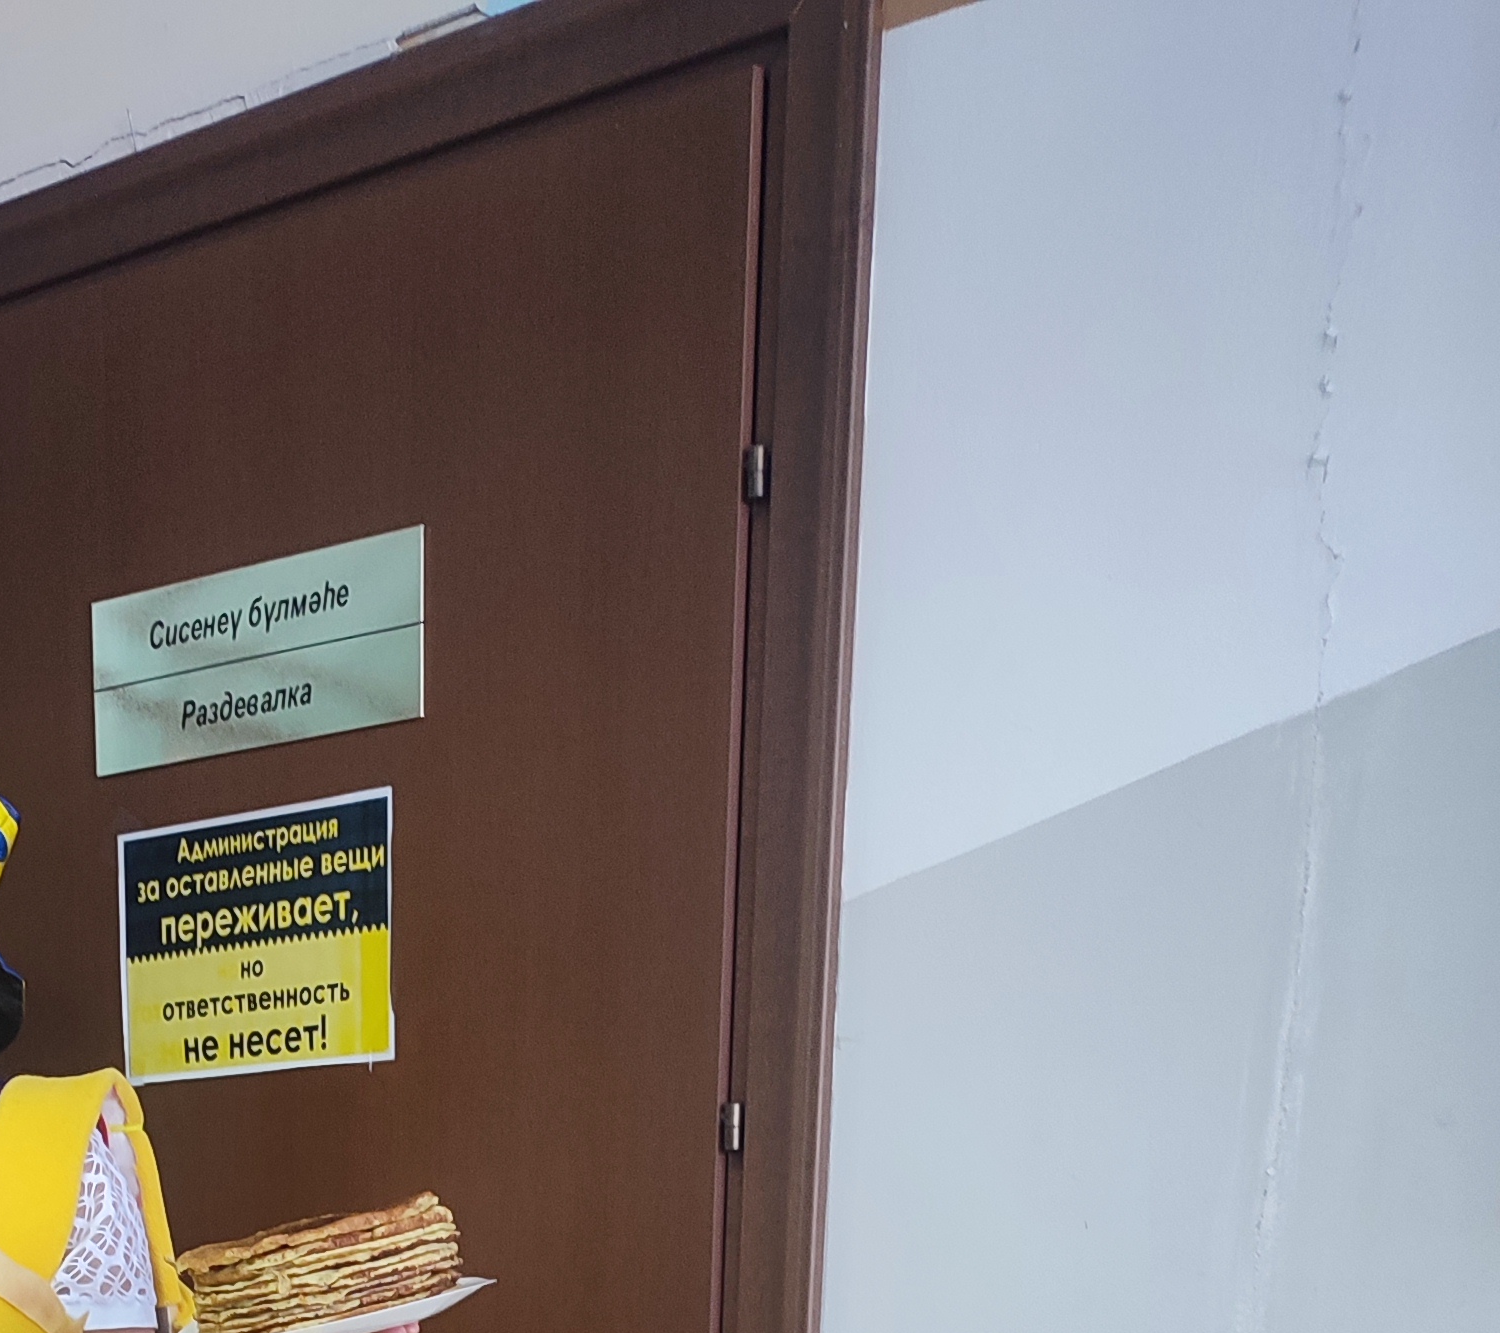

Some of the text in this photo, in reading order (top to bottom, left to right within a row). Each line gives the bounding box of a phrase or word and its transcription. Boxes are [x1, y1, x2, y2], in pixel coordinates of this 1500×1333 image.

[150, 580, 350, 650] Сисенеү бүлмәһе
[181, 682, 313, 731] Раздевалка
[176, 817, 339, 864] Администрация
[137, 844, 385, 903] за оставленные вещи
[161, 890, 359, 949] переживает,
[240, 959, 264, 979] но
[162, 982, 350, 1022] ответственность
[183, 1014, 328, 1064] не несет!
